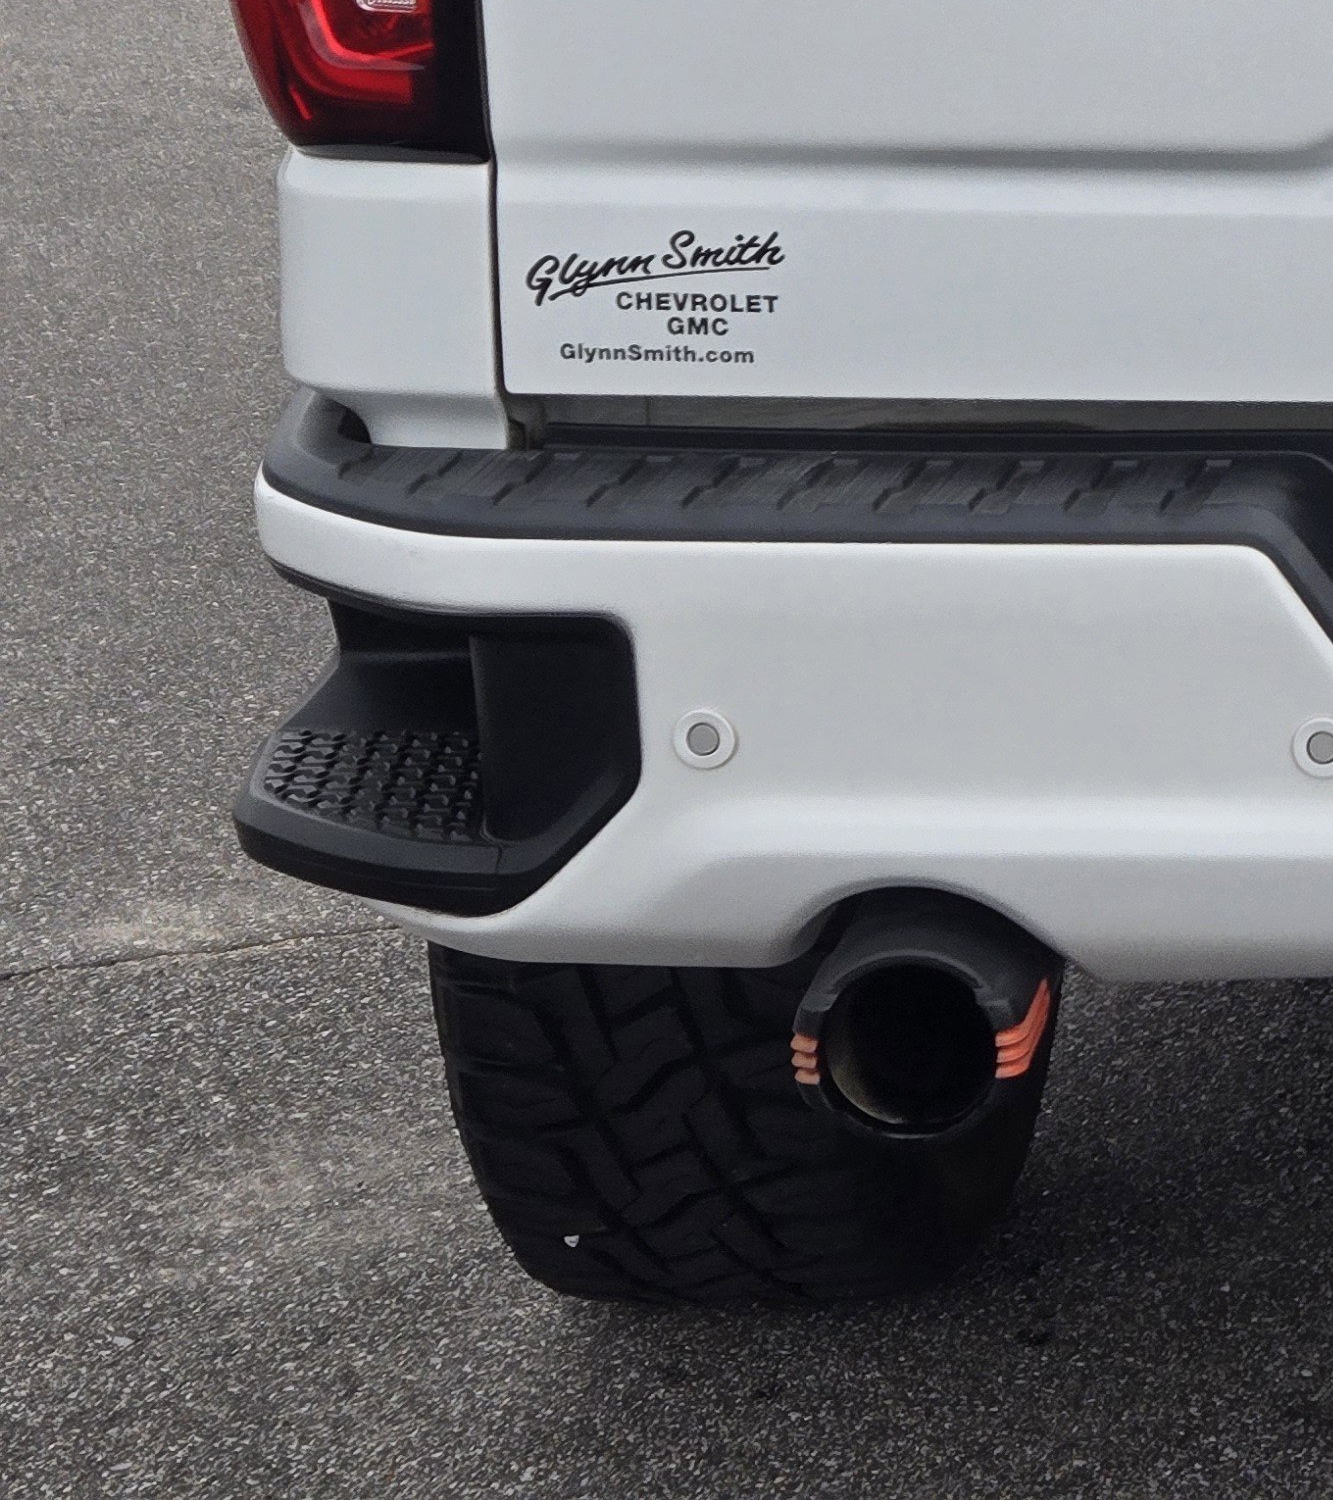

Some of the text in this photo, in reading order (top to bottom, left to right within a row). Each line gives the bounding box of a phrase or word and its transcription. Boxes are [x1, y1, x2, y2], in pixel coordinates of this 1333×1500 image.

[525, 229, 786, 306] Glynn Smith
[615, 291, 779, 313] CHEVROLET
[666, 316, 729, 336] GMC
[559, 342, 755, 364] GlynnSmith.com
